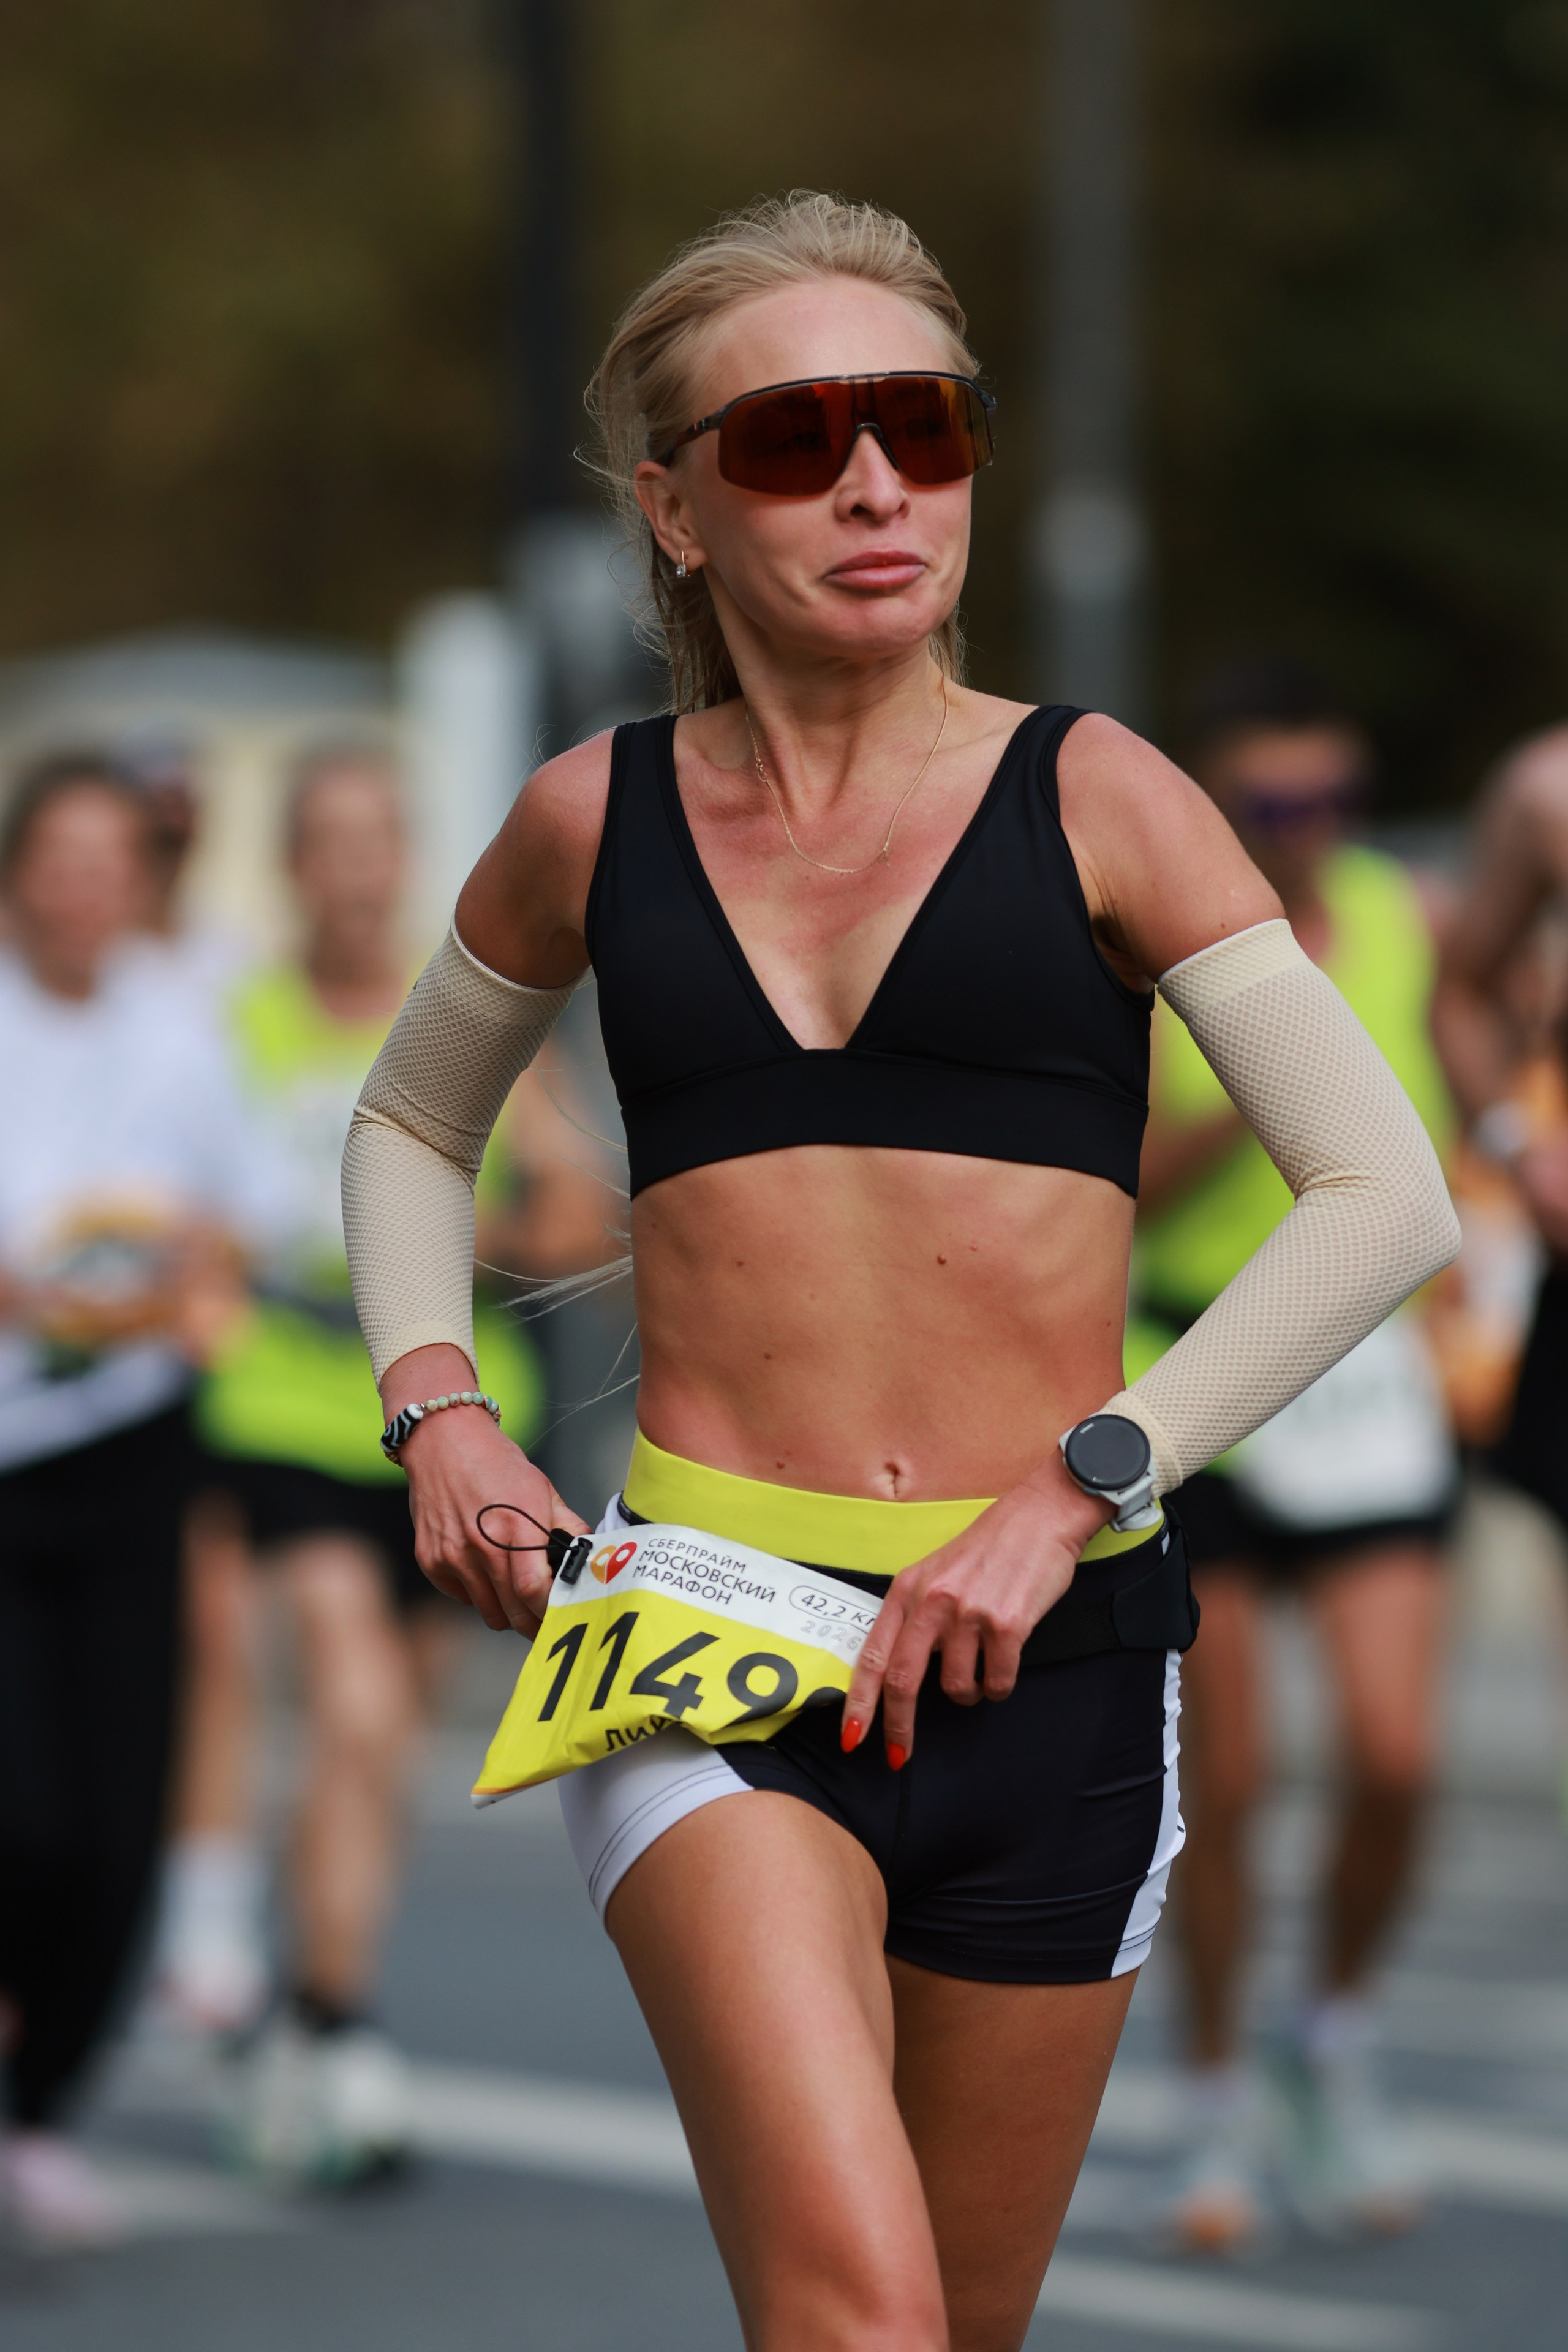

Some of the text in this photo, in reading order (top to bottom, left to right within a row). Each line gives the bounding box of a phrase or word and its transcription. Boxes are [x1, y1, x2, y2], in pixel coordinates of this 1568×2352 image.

[648, 1538, 747, 1574] СБЕРПРАЙМ
[632, 1565, 733, 1605] МАРАФОН
[638, 1550, 777, 1603] МОСКОВСКИЙ
[801, 1594, 846, 1618] 42,2
[799, 1620, 861, 1651] 2026
